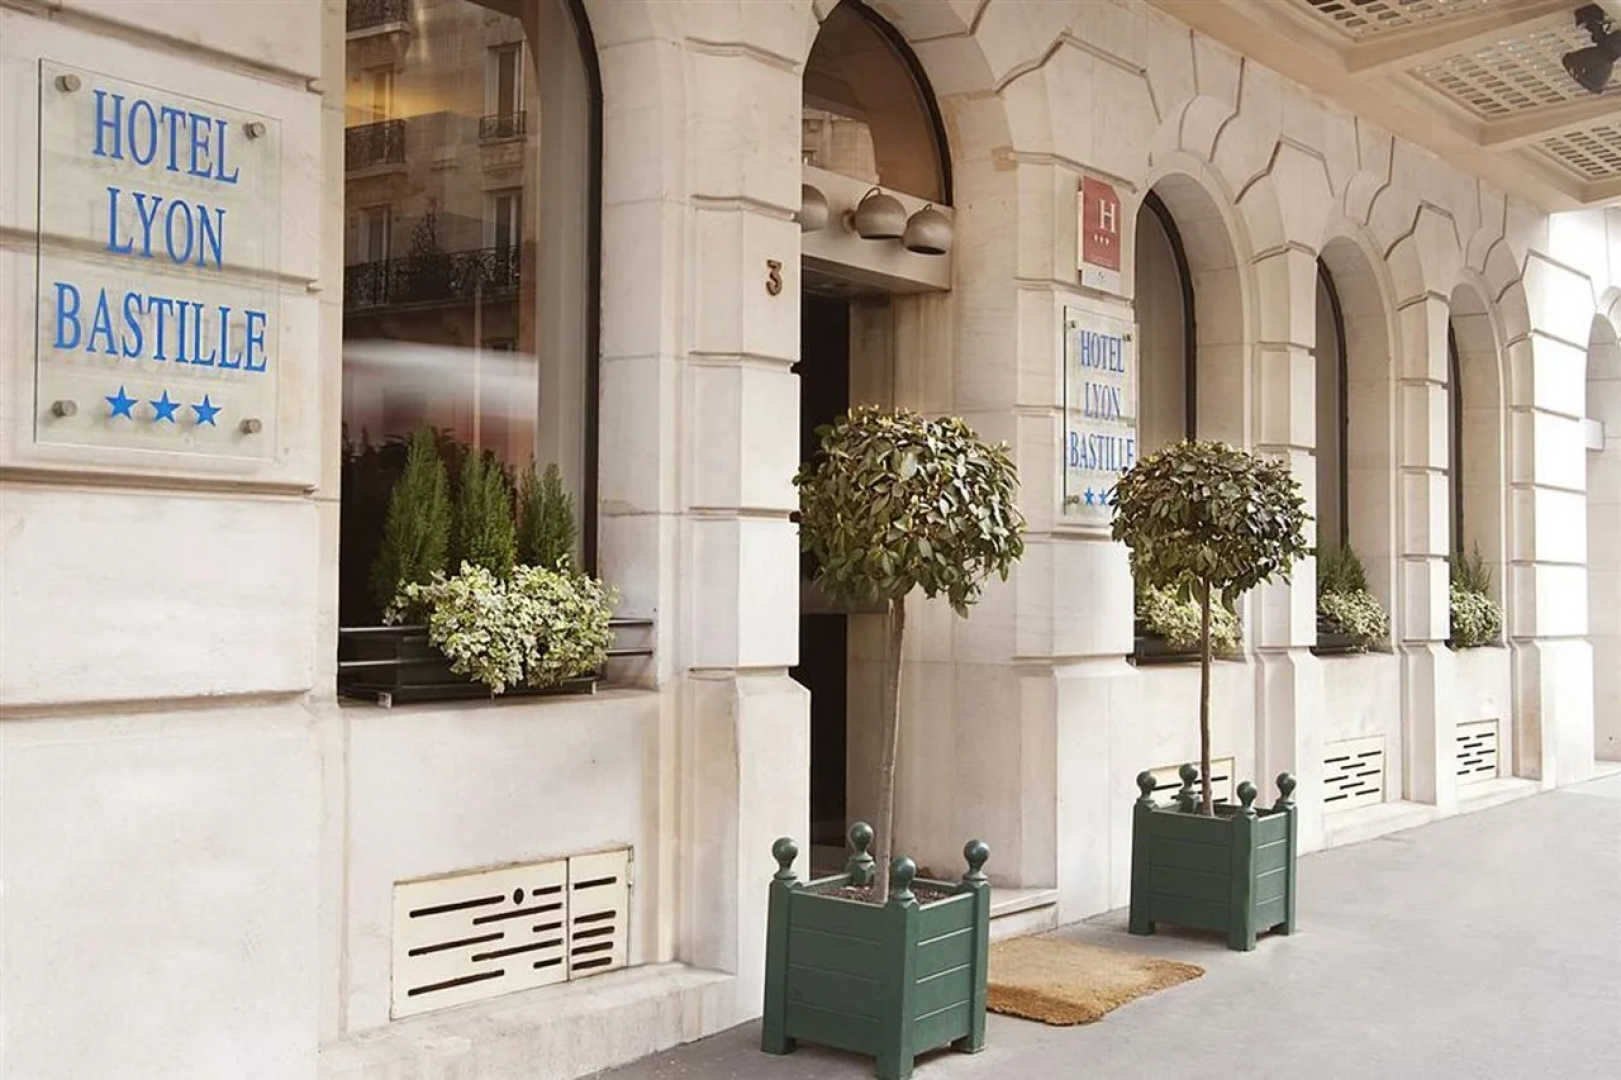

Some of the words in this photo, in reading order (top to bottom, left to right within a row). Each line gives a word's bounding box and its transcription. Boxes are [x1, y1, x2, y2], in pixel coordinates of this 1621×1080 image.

[92, 90, 239, 184] HOTEL
[105, 187, 227, 270] LYON
[1099, 198, 1116, 234] H
[765, 259, 783, 296] 3
[53, 282, 268, 373] BASTILLE
[1080, 330, 1125, 373] HOTEL
[1084, 382, 1121, 421] LYON
